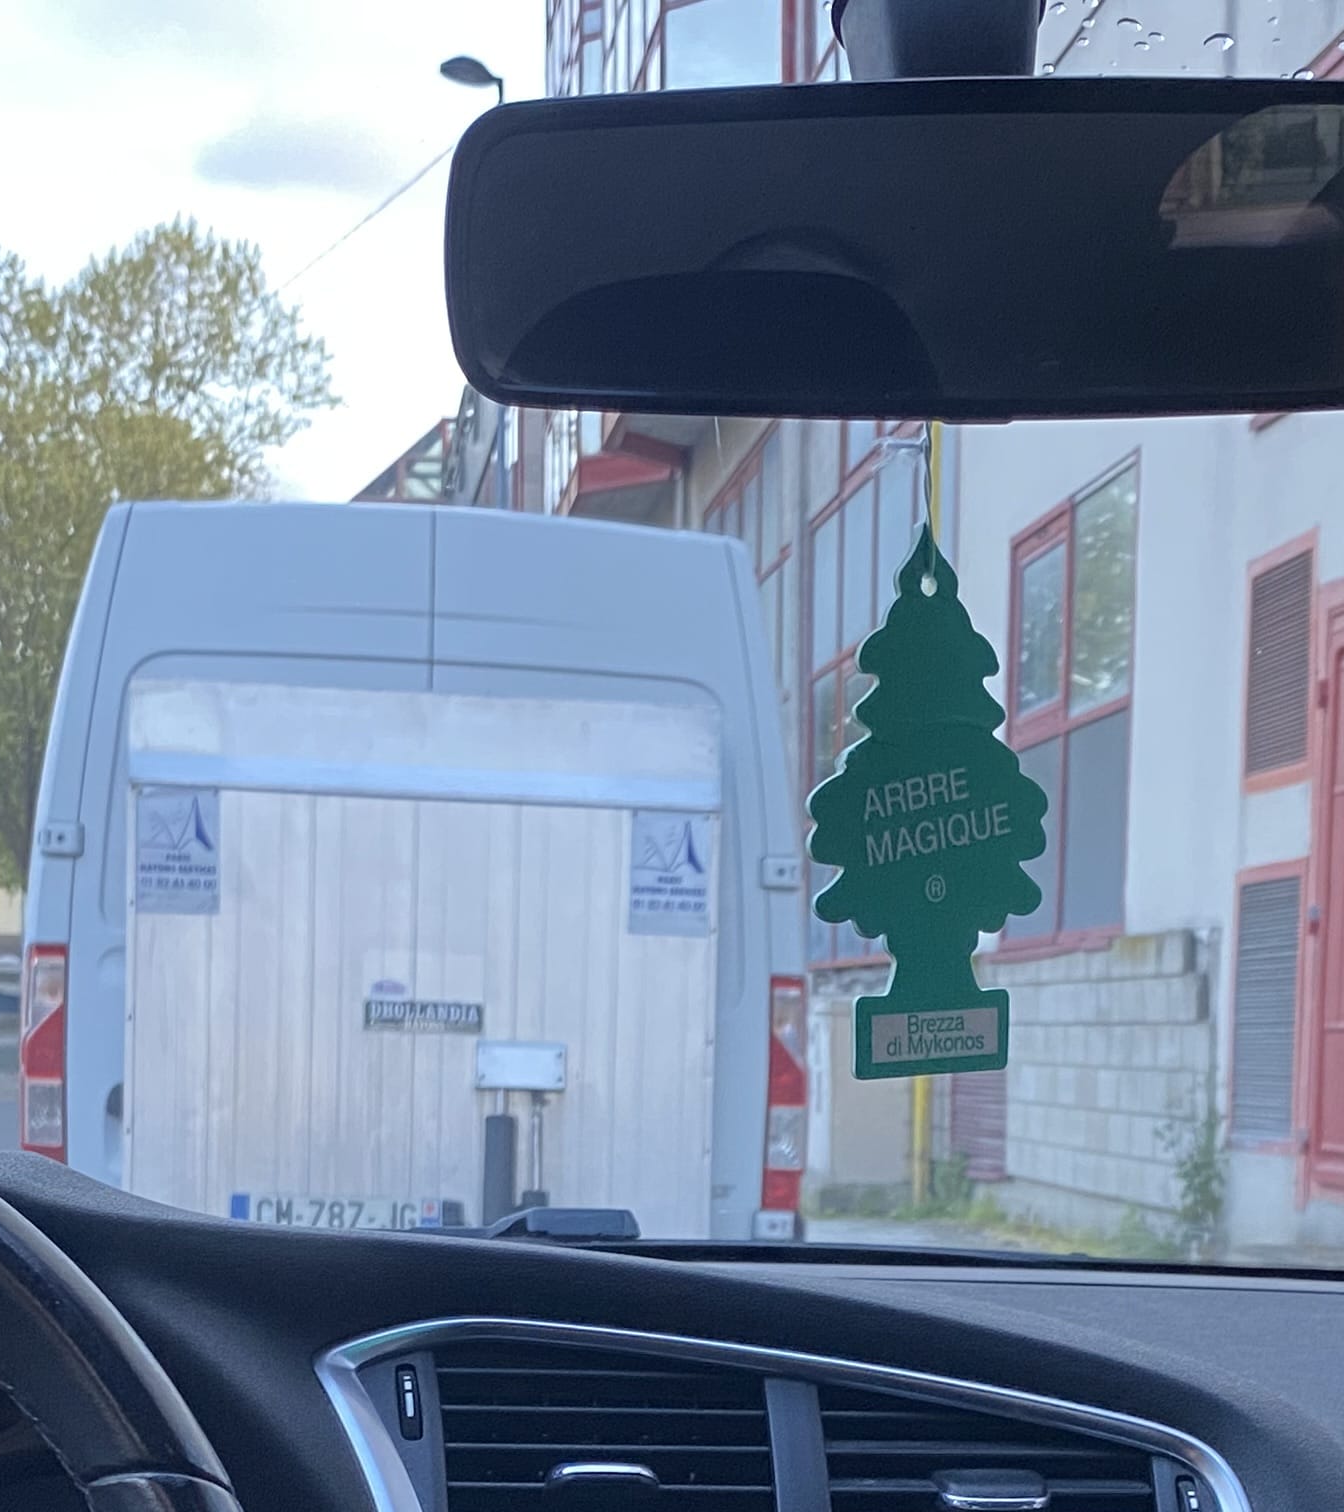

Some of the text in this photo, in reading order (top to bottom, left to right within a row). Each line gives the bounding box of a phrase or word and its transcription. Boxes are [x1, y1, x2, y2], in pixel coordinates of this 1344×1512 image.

[863, 767, 970, 822] ARBRE
[865, 802, 1012, 867] MAGIQUE
[906, 1013, 966, 1036] Brezza
[886, 1032, 985, 1059] di Mykonos
